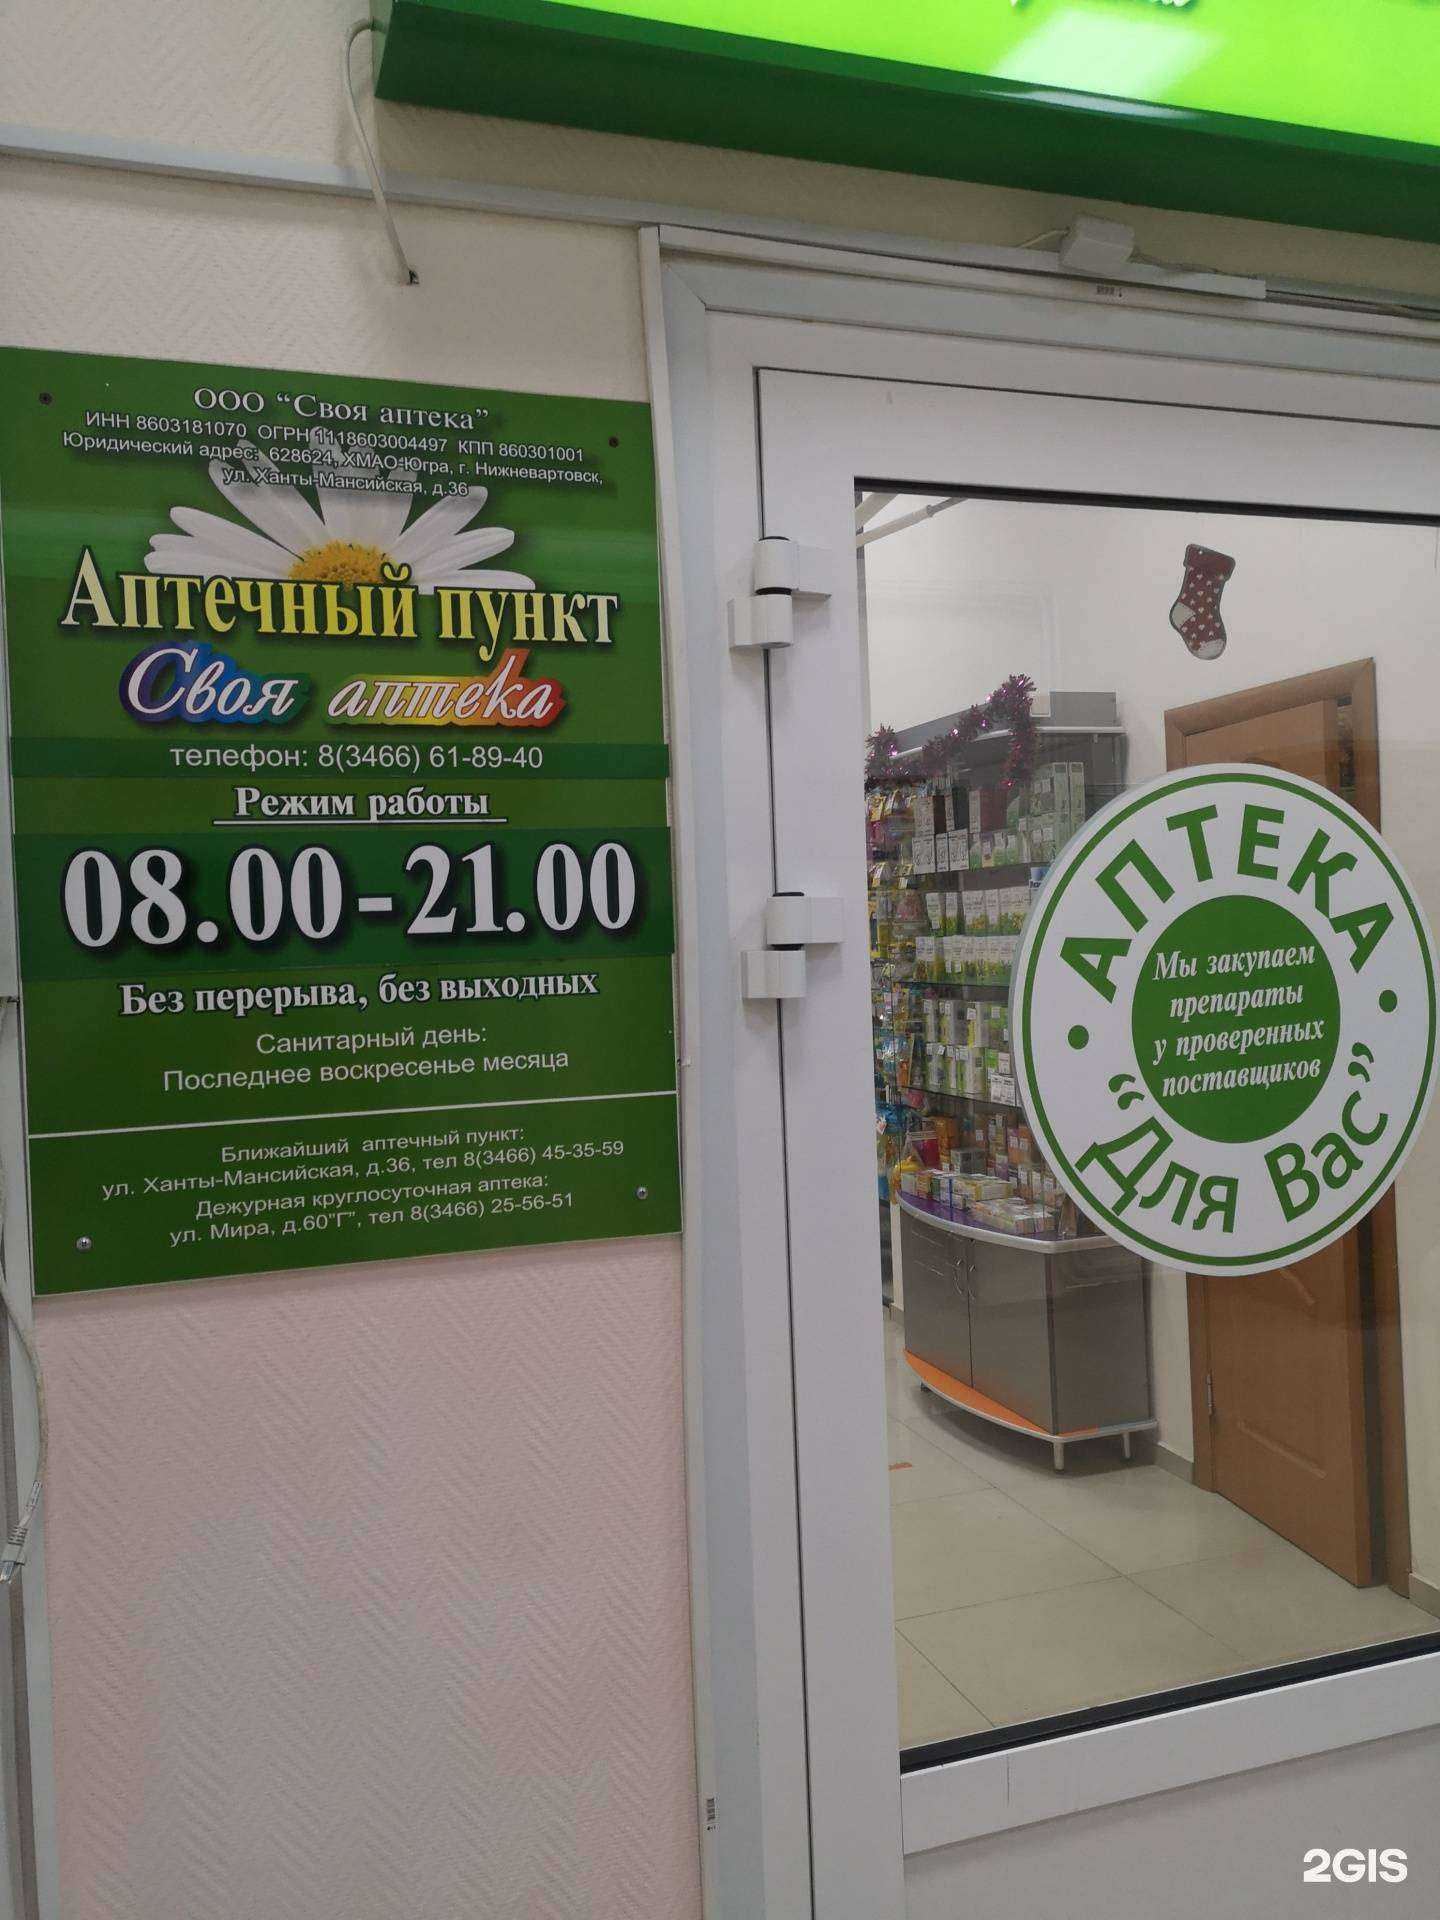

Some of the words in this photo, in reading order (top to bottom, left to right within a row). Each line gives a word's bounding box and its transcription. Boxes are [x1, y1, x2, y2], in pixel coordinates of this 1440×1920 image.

[193, 387, 265, 413] ООО
[85, 411, 130, 430] ИНН
[136, 415, 248, 438] 8603181070
[257, 424, 309, 442] ОГРН
[315, 427, 447, 453] 1118603004497
[458, 439, 494, 456] КПП
[499, 443, 583, 462] 860301001
[63, 431, 193, 455] Юридический
[199, 444, 260, 462] адрес:
[268, 447, 339, 468] 628624,
[459, 463, 470, 475] г.
[475, 462, 603, 485] Нижневартовск,
[223, 469, 249, 484] ул.
[254, 468, 427, 497] Ханты-Мансийская,
[432, 481, 468, 497] д.36
[60, 547, 418, 638] Аптечный
[437, 588, 618, 662] пункт
[128, 647, 298, 716] Своя
[327, 654, 555, 720] аптека
[170, 743, 308, 772] телефон:
[318, 744, 420, 773] 8(3466)
[429, 746, 543, 768] 61-89-40
[233, 787, 355, 816] Режим
[369, 787, 490, 822] работы
[1060, 804, 1394, 1003] АПТЕКА
[1152, 951, 1197, 980] Мы
[1206, 945, 1315, 978] закупаем
[120, 984, 184, 1015] Без
[195, 983, 368, 1017] перерыва,
[379, 973, 431, 1003] без
[440, 974, 599, 1000] выходных
[1169, 984, 1304, 1023] препараты
[256, 1026, 415, 1055] Санитарный
[422, 1027, 487, 1048] день:
[1153, 1039, 1167, 1066] у
[1176, 1020, 1324, 1061] проверенных
[163, 1067, 311, 1092] Последнее
[320, 1056, 475, 1083] воскресенье
[483, 1052, 569, 1072] месяца
[1162, 1058, 1321, 1097] поставщиков
[221, 1137, 350, 1163] Ближайший
[362, 1130, 460, 1152] аптечный
[466, 1127, 525, 1147] пункт:
[102, 1183, 135, 1200] ул.
[143, 1163, 360, 1194] Ханты-Мансийская,
[366, 1157, 416, 1178] д.36,
[422, 1155, 457, 1170] тел
[463, 1147, 536, 1168] 8(3466)
[542, 1140, 624, 1160] 45-35-59
[196, 1195, 305, 1221] Дежурная
[312, 1181, 471, 1210] круглосуточная
[478, 1174, 549, 1192] аптека:
[170, 1229, 202, 1248] ул.
[210, 1222, 275, 1243] Мира,
[368, 1209, 403, 1225] тел
[410, 1200, 485, 1223] 8(3466)
[491, 1192, 573, 1214] 25-56-51
